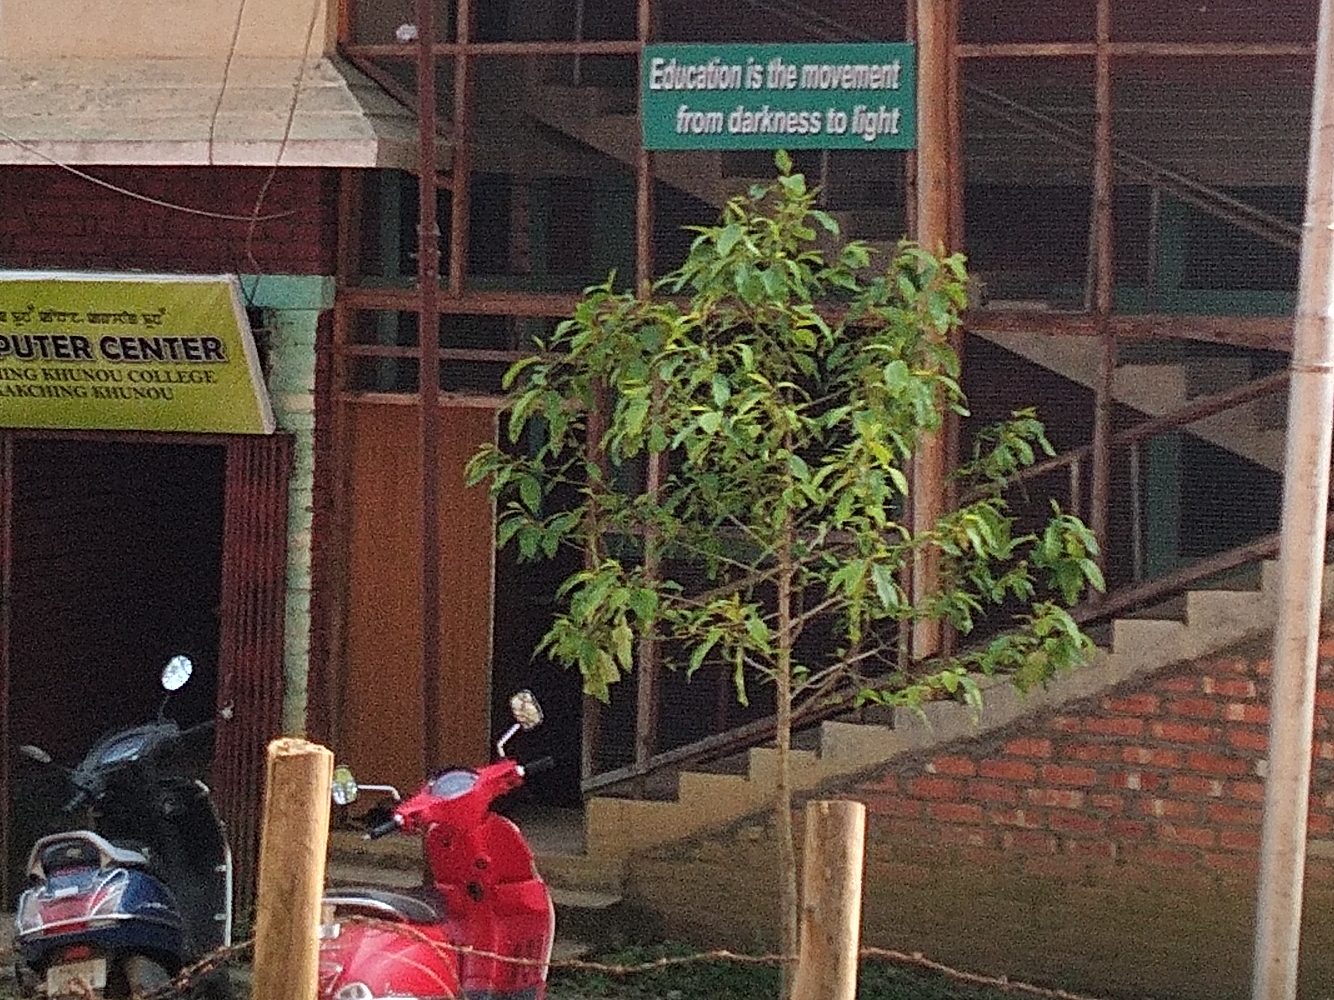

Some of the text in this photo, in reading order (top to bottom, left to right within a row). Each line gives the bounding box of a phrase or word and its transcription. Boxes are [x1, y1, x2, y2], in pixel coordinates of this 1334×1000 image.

[649, 56, 901, 90] Education is the movement
[676, 105, 901, 141] from darkness to light
[101, 335, 227, 363] CENTER
[41, 367, 123, 383] KHUNOU
[127, 369, 217, 384] COLLEGE
[92, 385, 174, 400] KHUNOU
